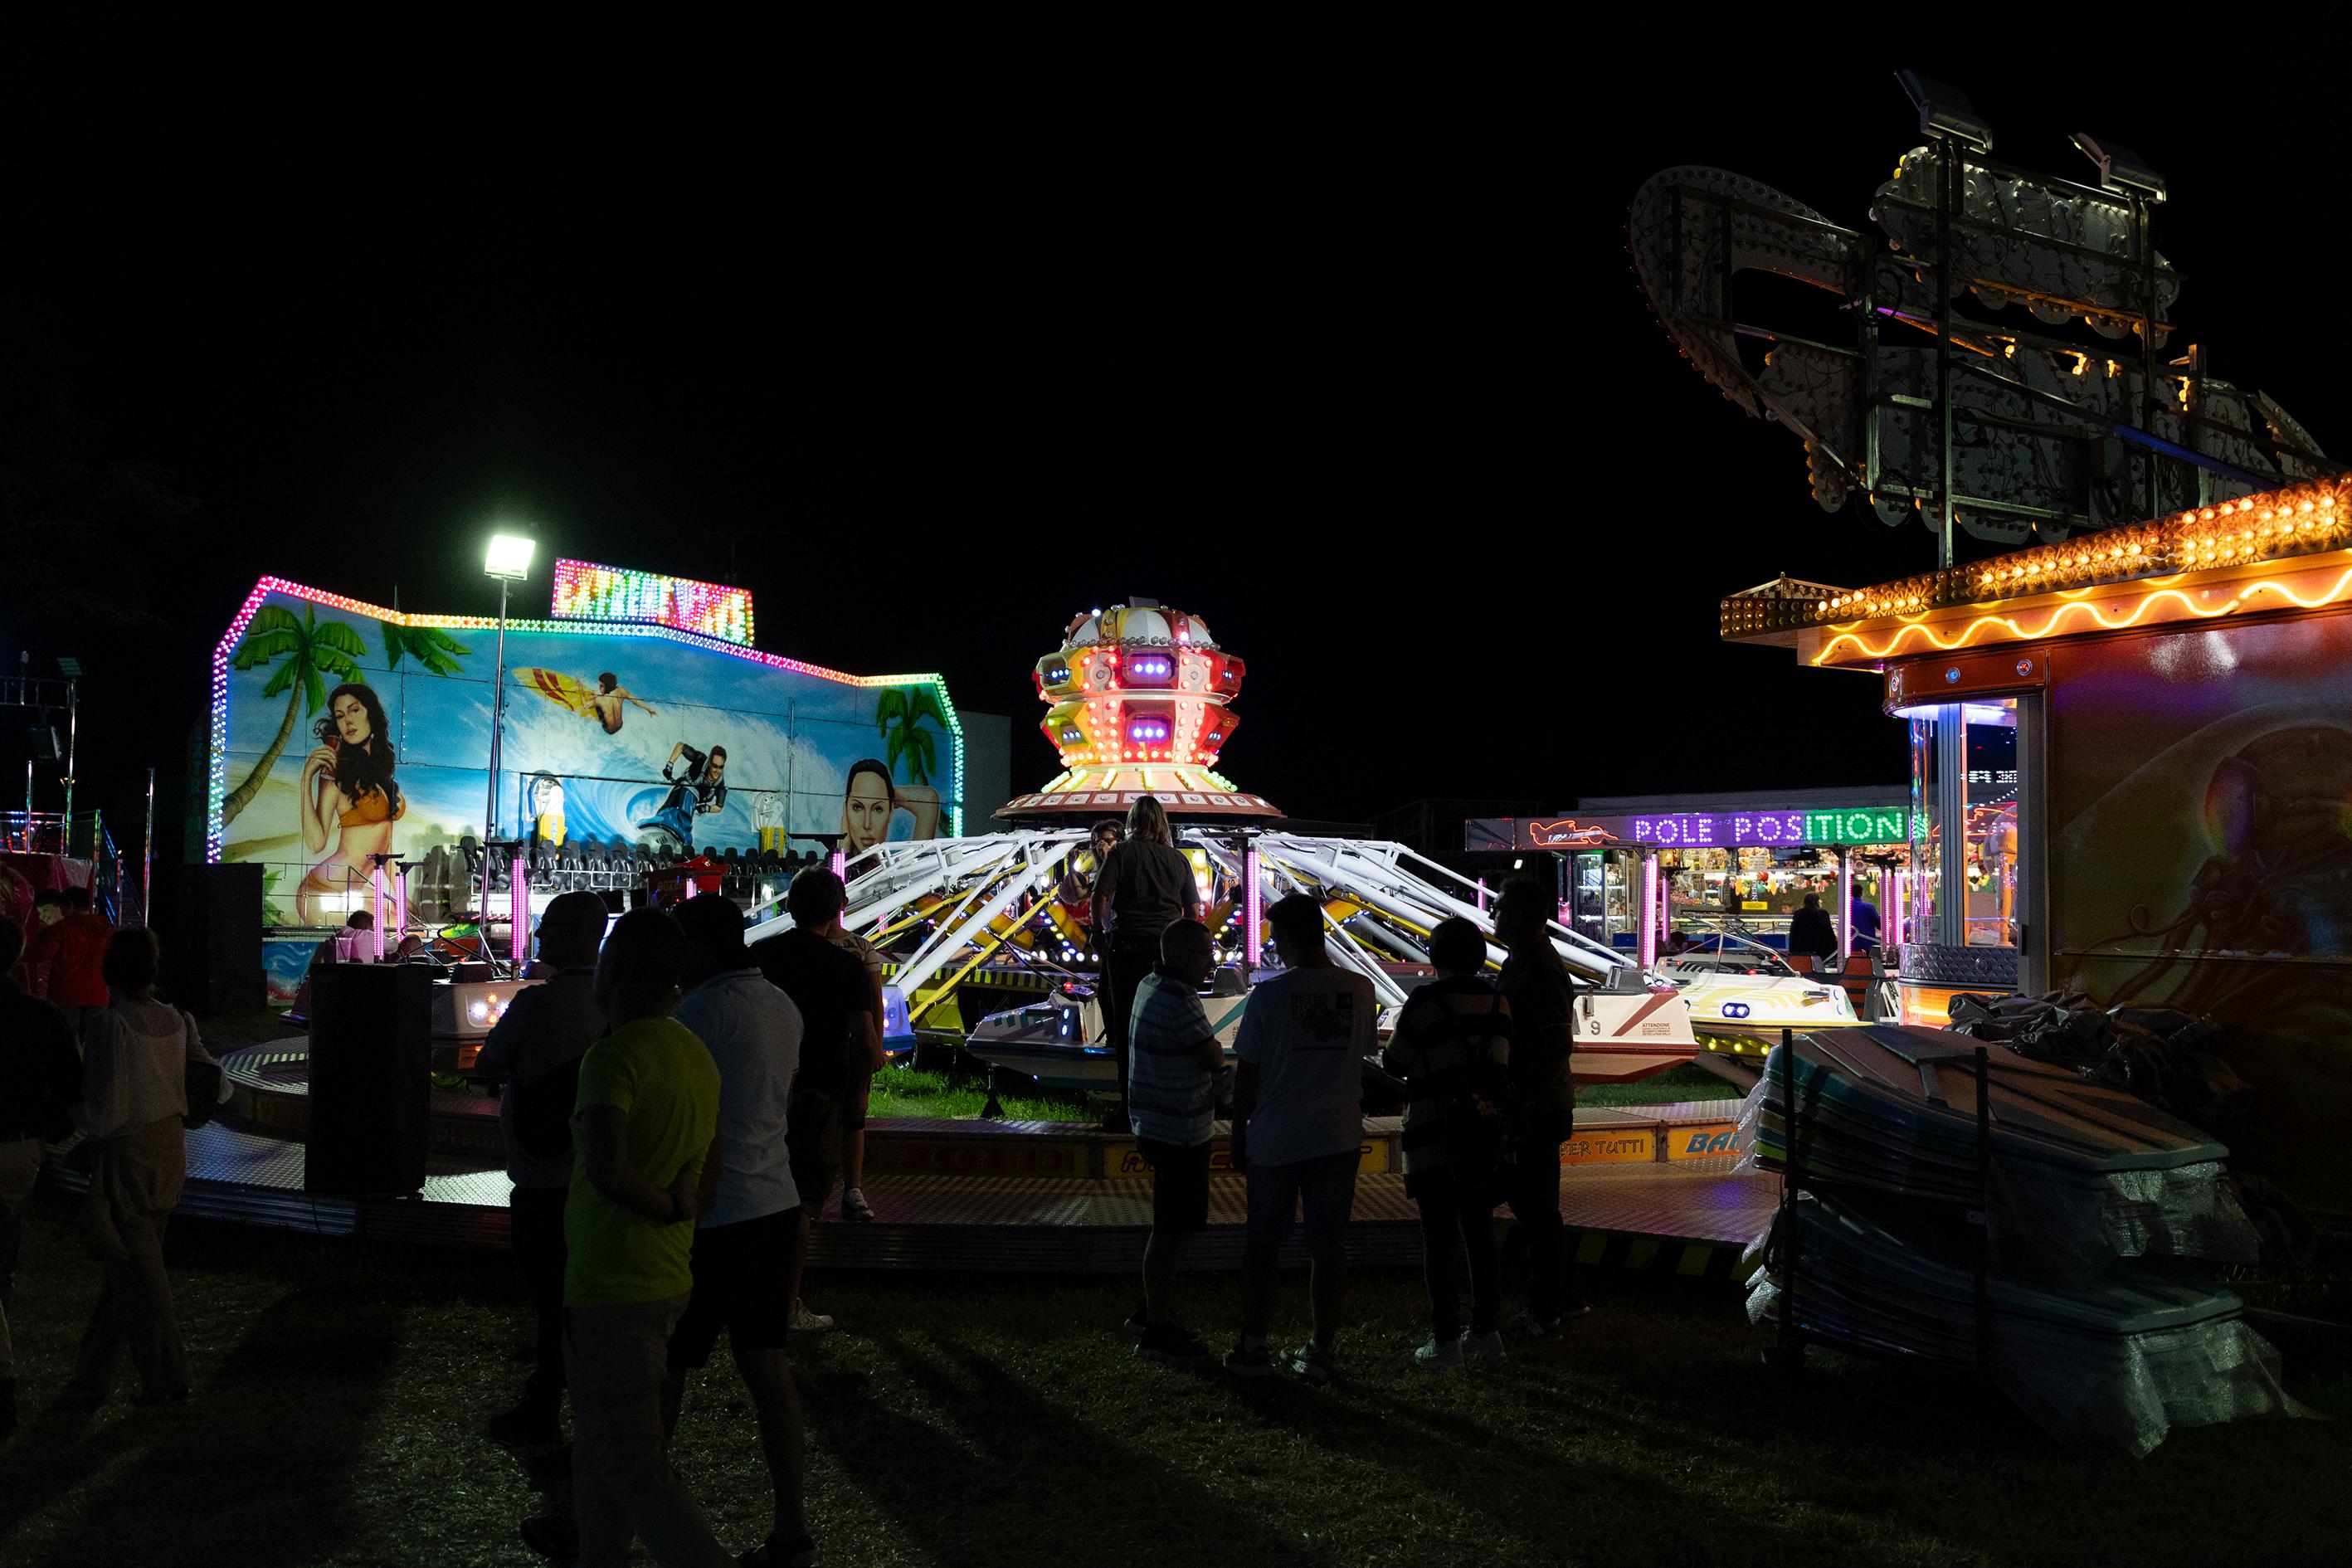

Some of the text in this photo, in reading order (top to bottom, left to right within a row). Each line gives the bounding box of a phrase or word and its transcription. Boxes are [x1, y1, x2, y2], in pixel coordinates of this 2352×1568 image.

[1636, 812, 1903, 843] POLE POSITION
[1590, 1020, 1601, 1035] 9
[1595, 1138, 1645, 1155] TUTTI
